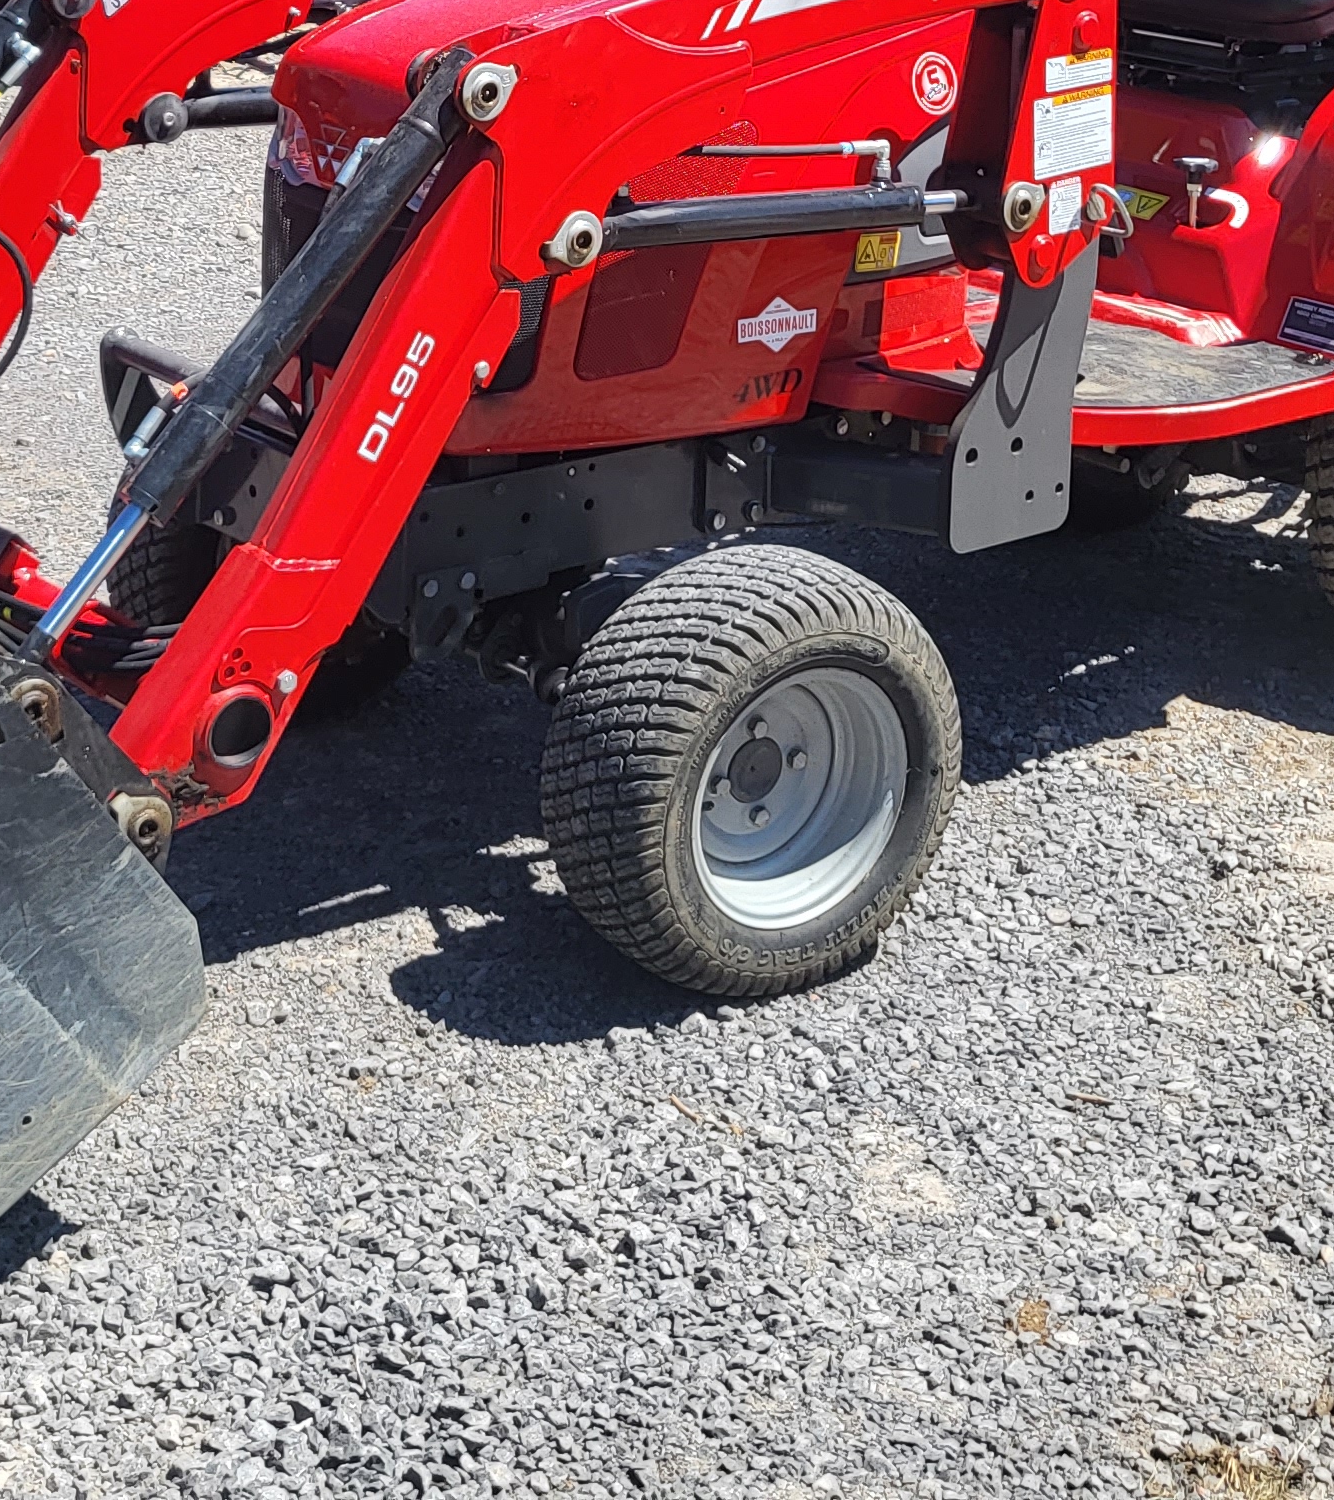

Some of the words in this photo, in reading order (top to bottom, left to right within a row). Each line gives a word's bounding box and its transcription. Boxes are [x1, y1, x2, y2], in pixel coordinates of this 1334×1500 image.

[740, 312, 815, 339] BOISSONNAULT
[356, 330, 436, 463] DL95
[732, 367, 803, 403] 4WD
